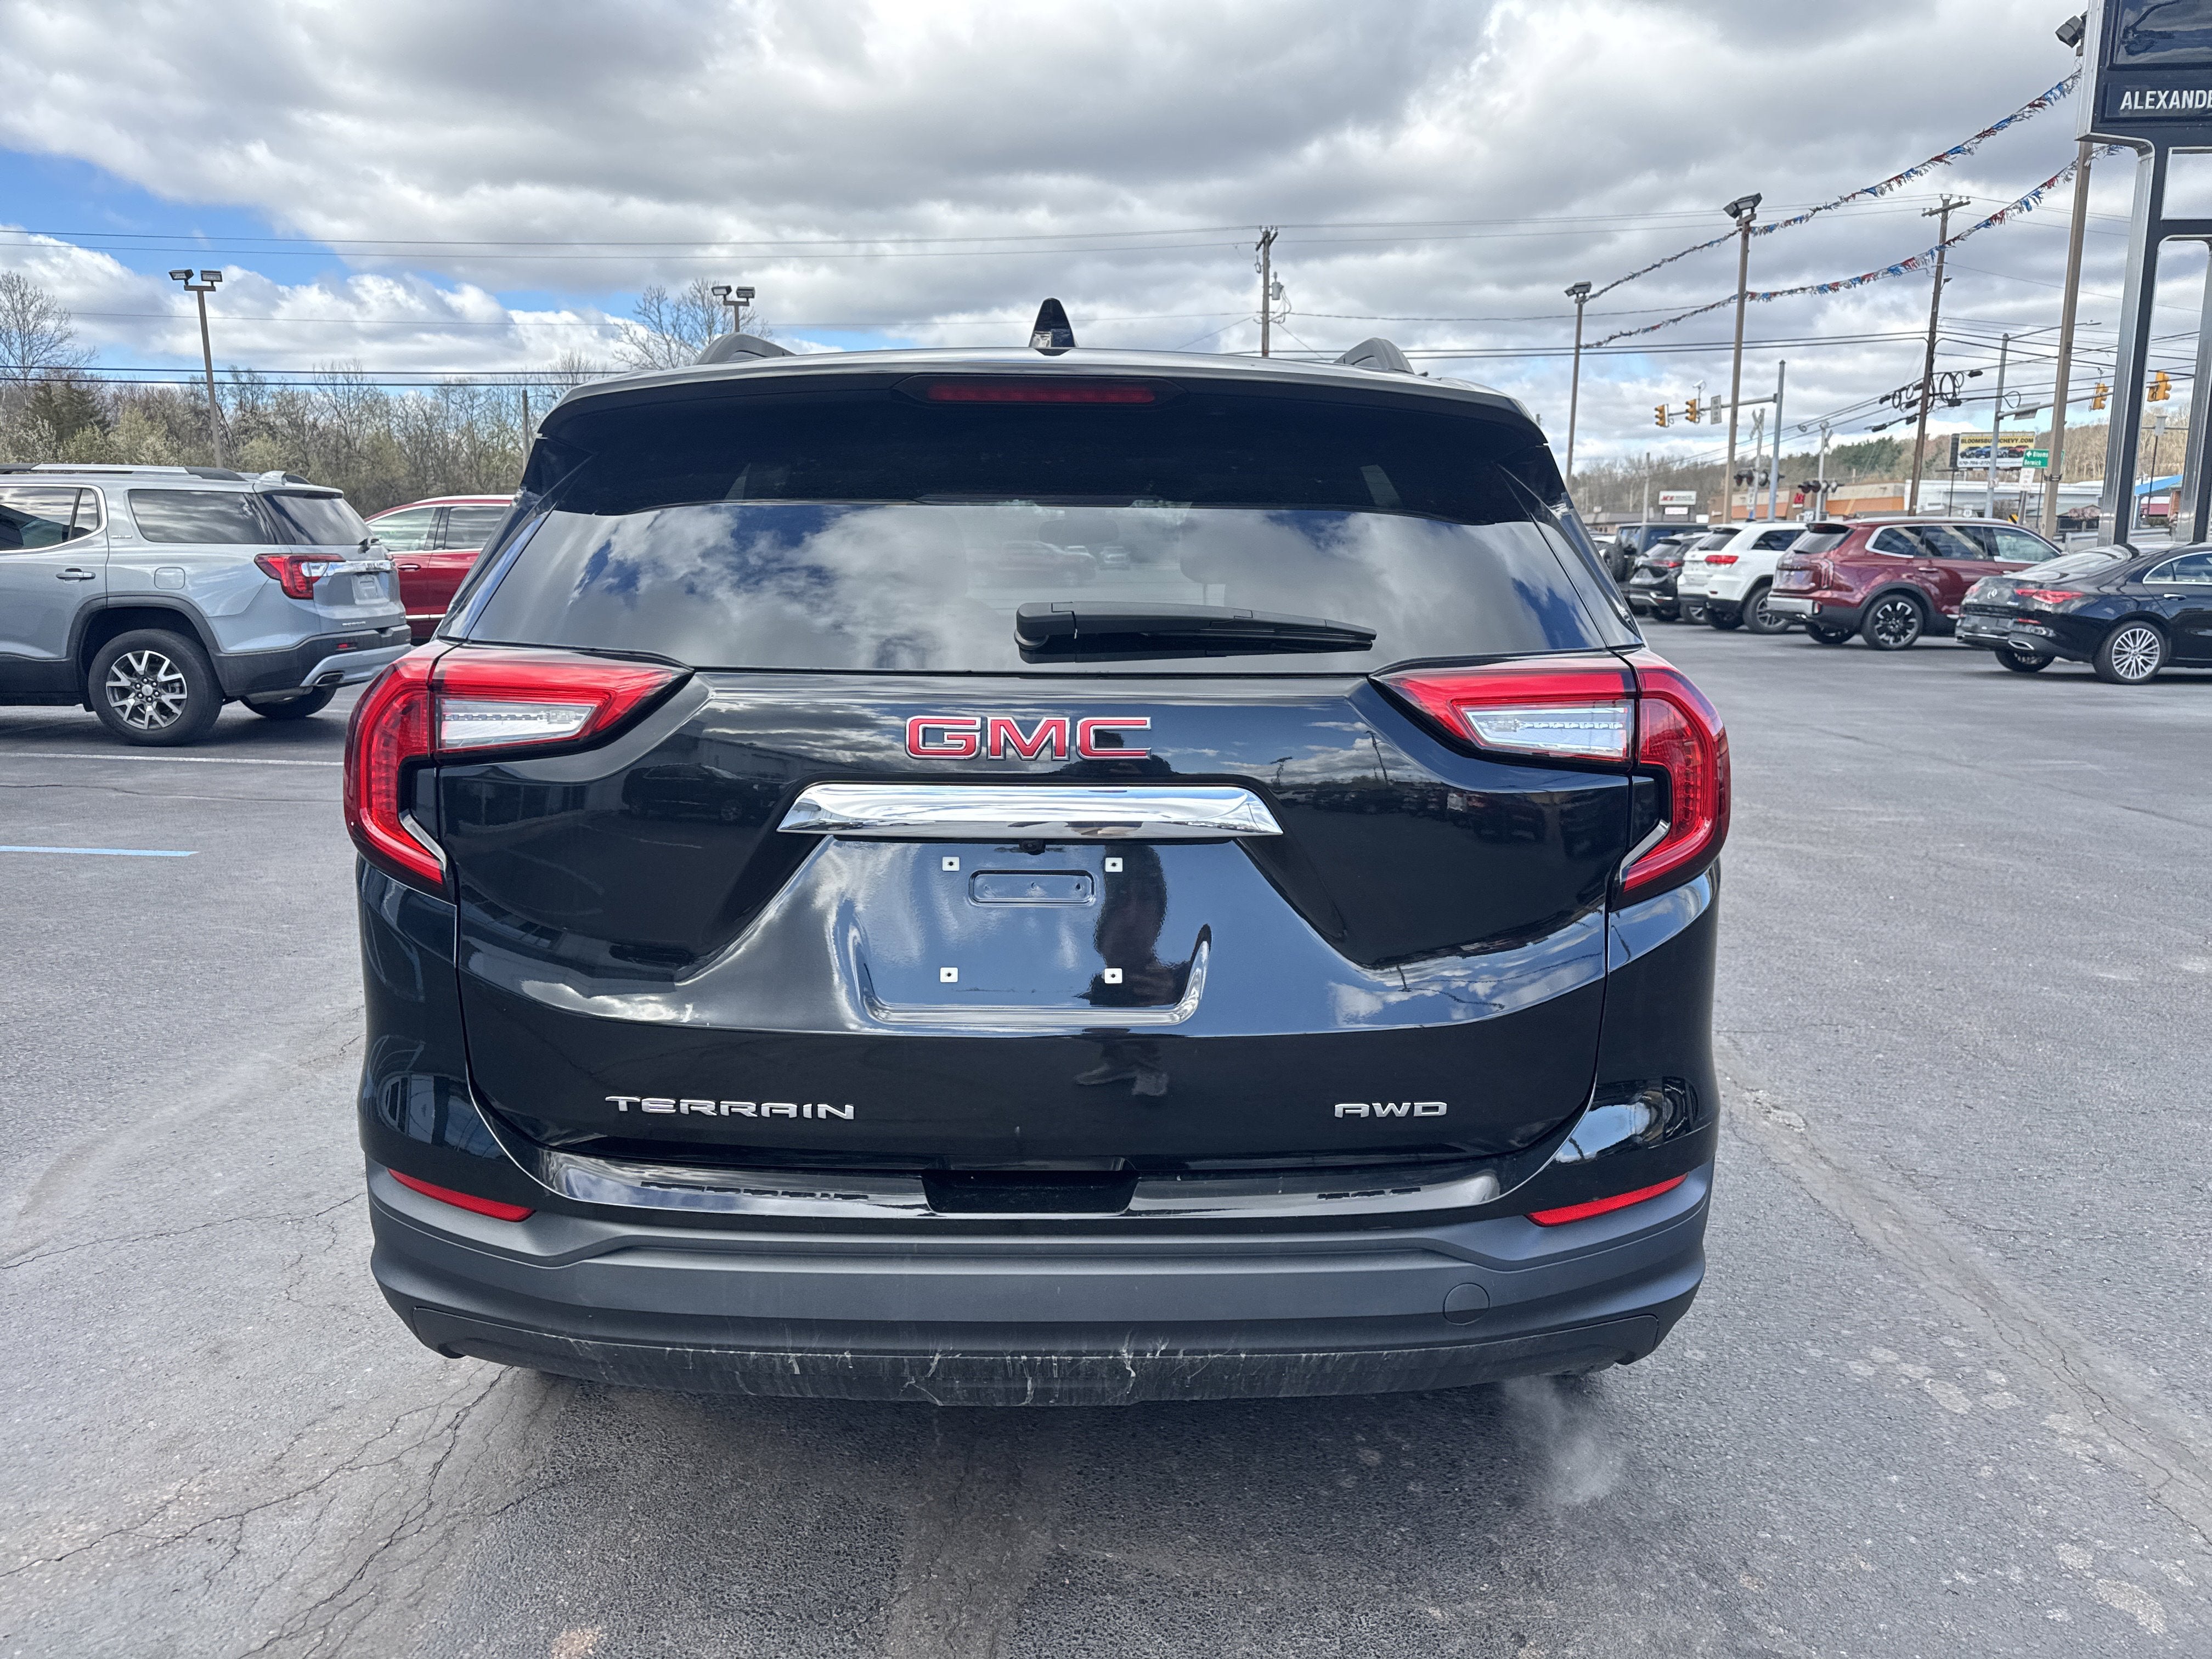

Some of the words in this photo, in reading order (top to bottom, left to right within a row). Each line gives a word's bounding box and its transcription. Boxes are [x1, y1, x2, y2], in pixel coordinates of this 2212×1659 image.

[905, 715, 1152, 760] GMC
[605, 1096, 854, 1120] TERRAIN
[1334, 1102, 1447, 1118] AWD
